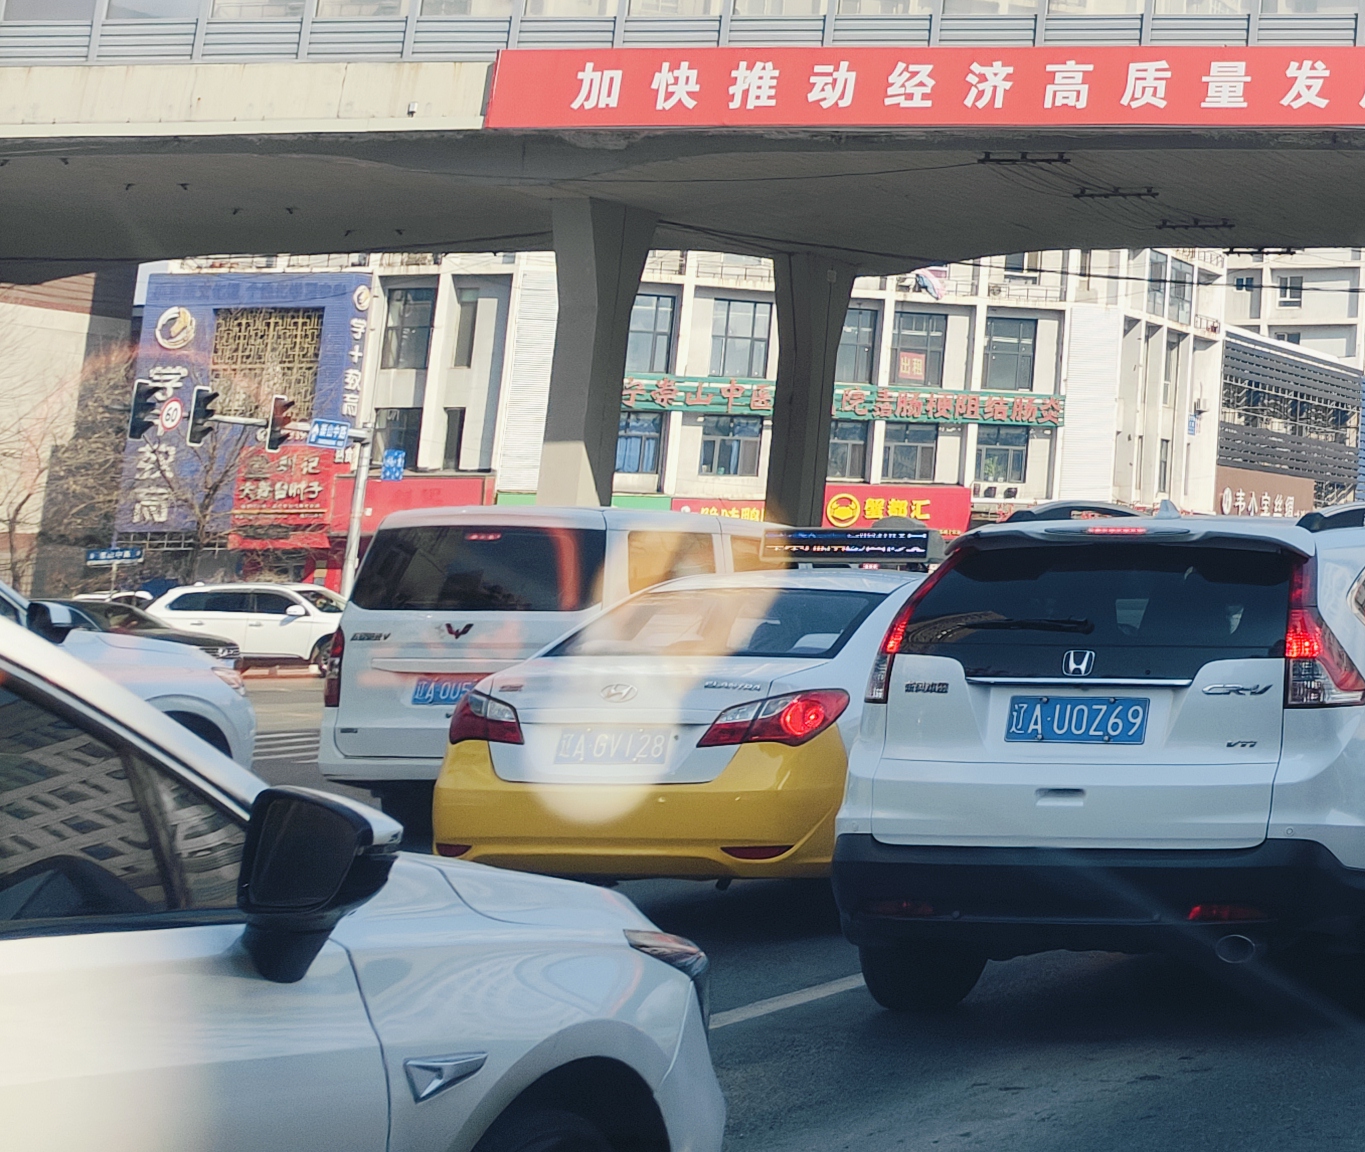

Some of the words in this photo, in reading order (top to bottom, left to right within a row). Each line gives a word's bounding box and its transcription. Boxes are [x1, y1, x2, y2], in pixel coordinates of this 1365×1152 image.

[900, 356, 924, 376] 出租
[164, 408, 179, 423] 60
[132, 365, 189, 523] 学教育
[864, 498, 930, 519] 蟹都汇
